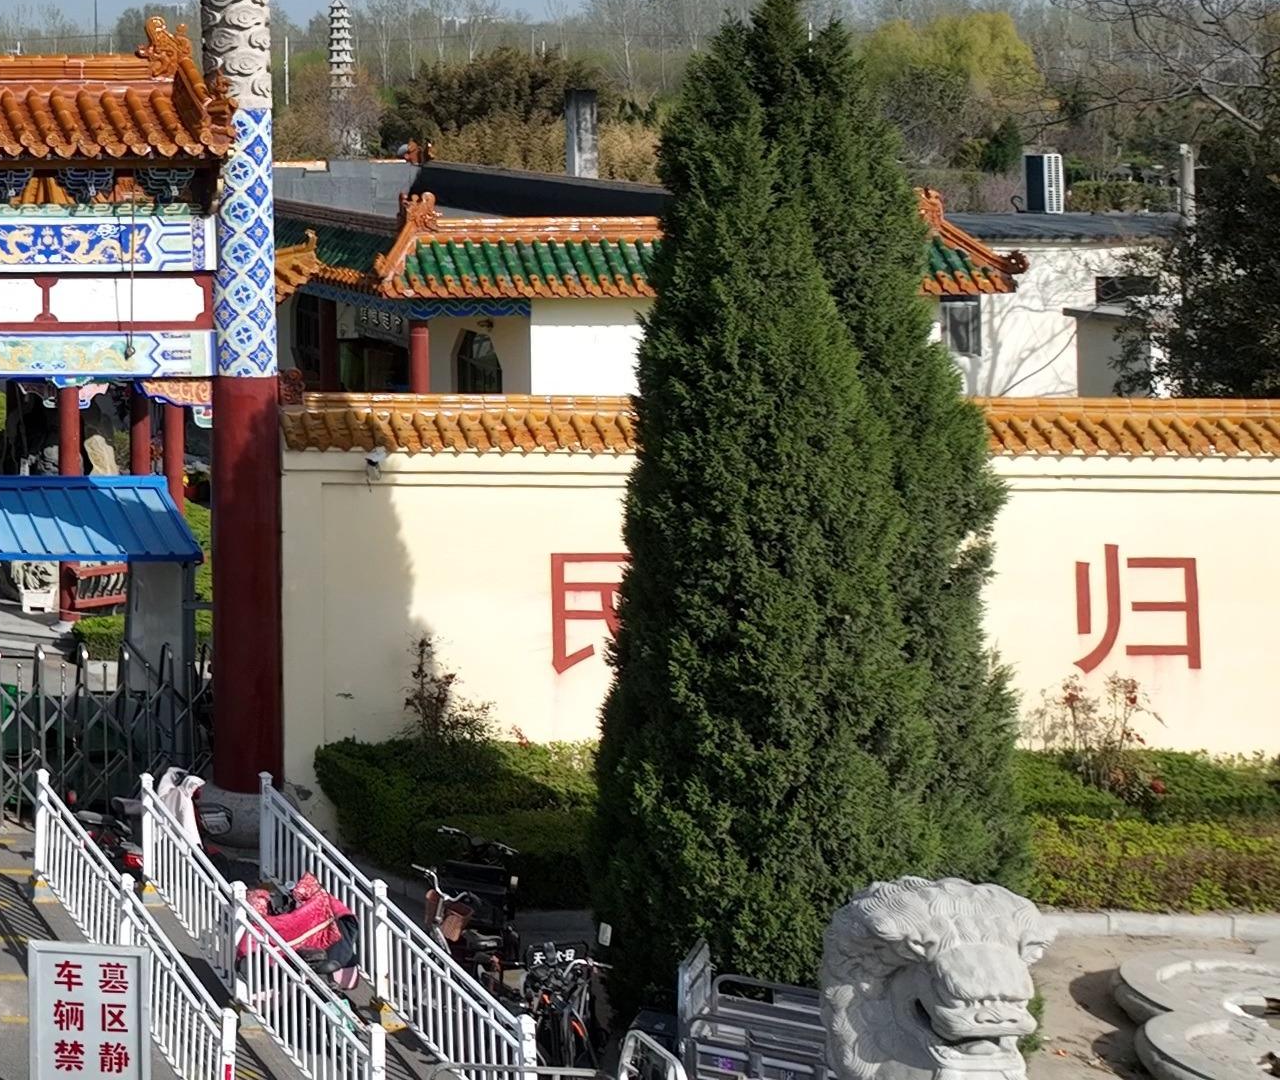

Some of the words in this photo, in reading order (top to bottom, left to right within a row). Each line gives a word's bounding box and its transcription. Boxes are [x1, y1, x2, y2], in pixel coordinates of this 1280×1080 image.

[52, 960, 85, 1072] 车辆禁
[98, 962, 131, 1074] 墓区静
